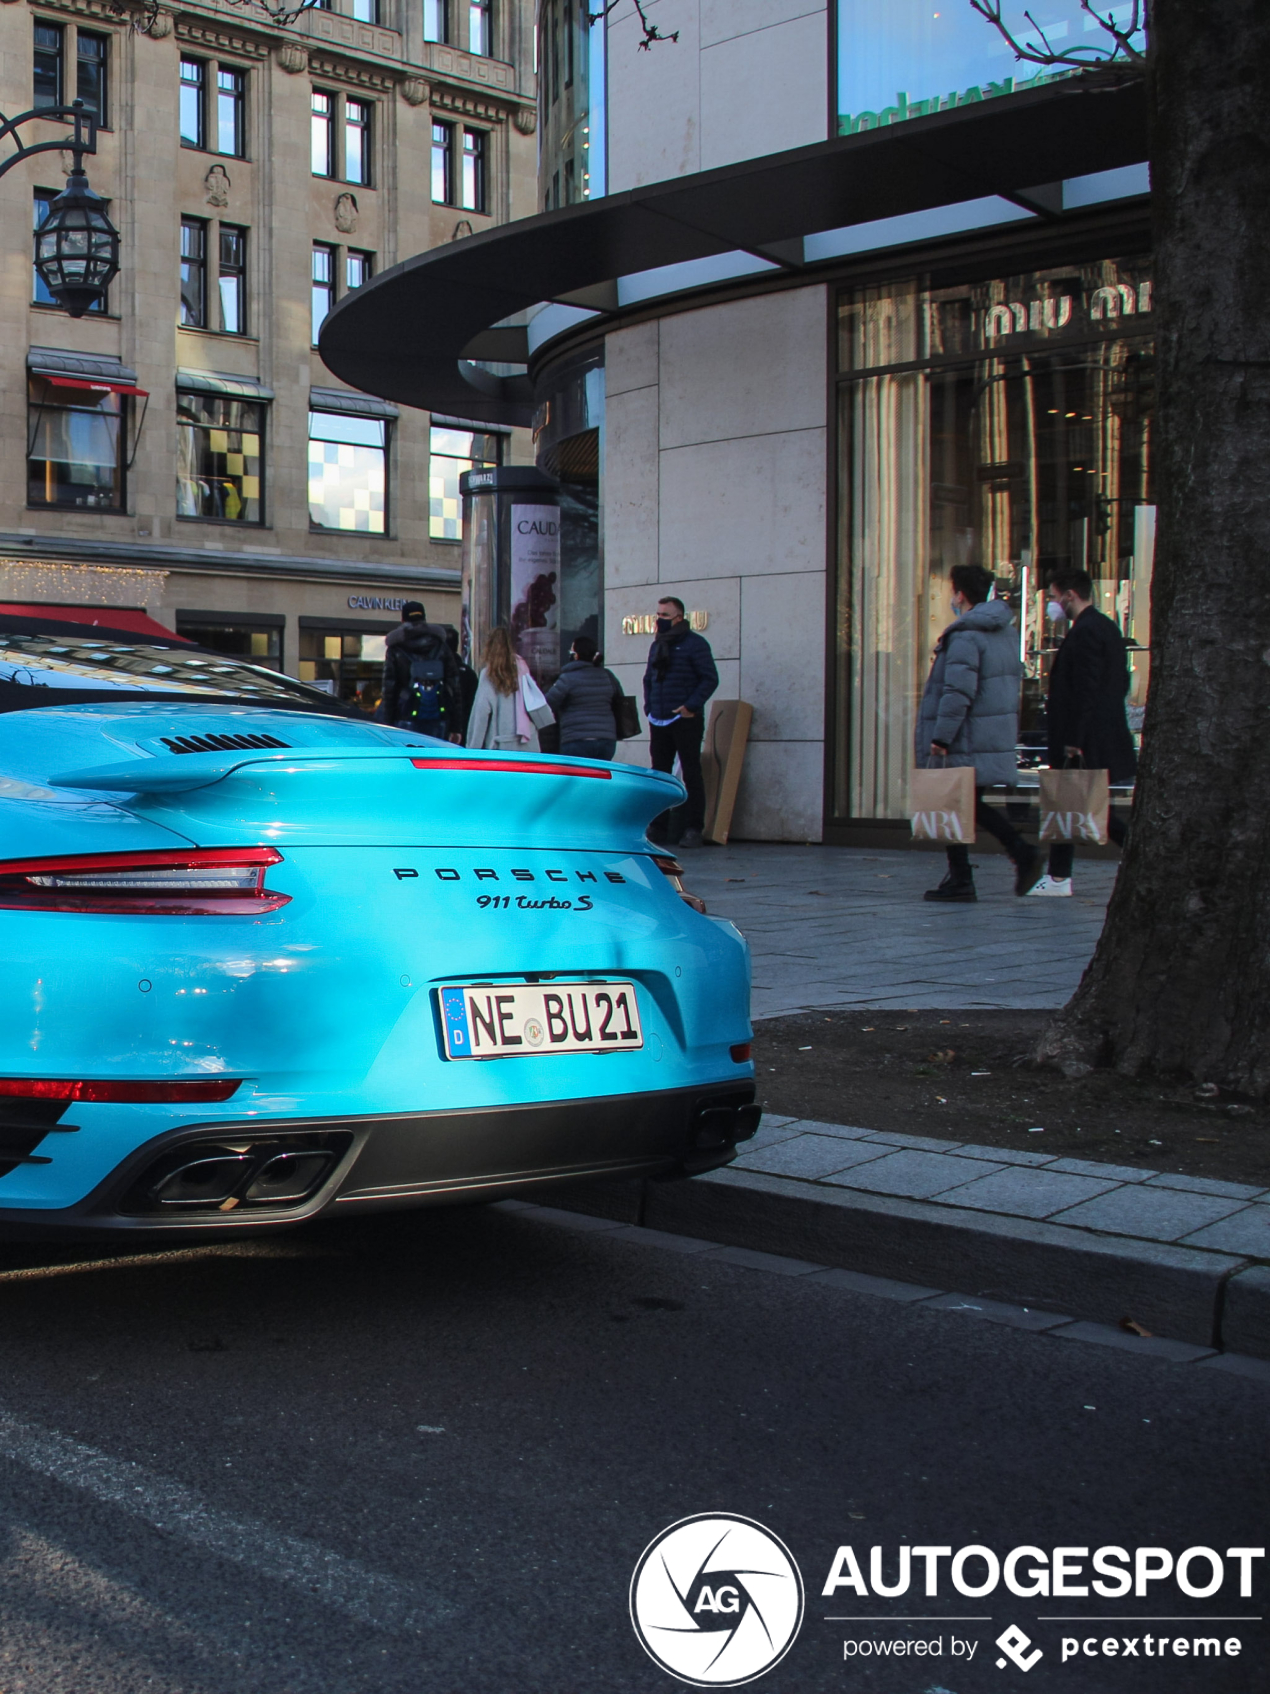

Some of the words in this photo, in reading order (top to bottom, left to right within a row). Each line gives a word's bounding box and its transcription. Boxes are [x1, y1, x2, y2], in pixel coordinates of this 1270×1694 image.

[349, 595, 383, 609] CALVIN
[911, 811, 963, 840] ZARA
[1038, 811, 1101, 841] ZARA
[392, 868, 626, 883] PORSCHE
[476, 895, 510, 909] 911
[573, 895, 593, 911] S
[453, 1029, 463, 1045] D
[469, 994, 522, 1046] NE
